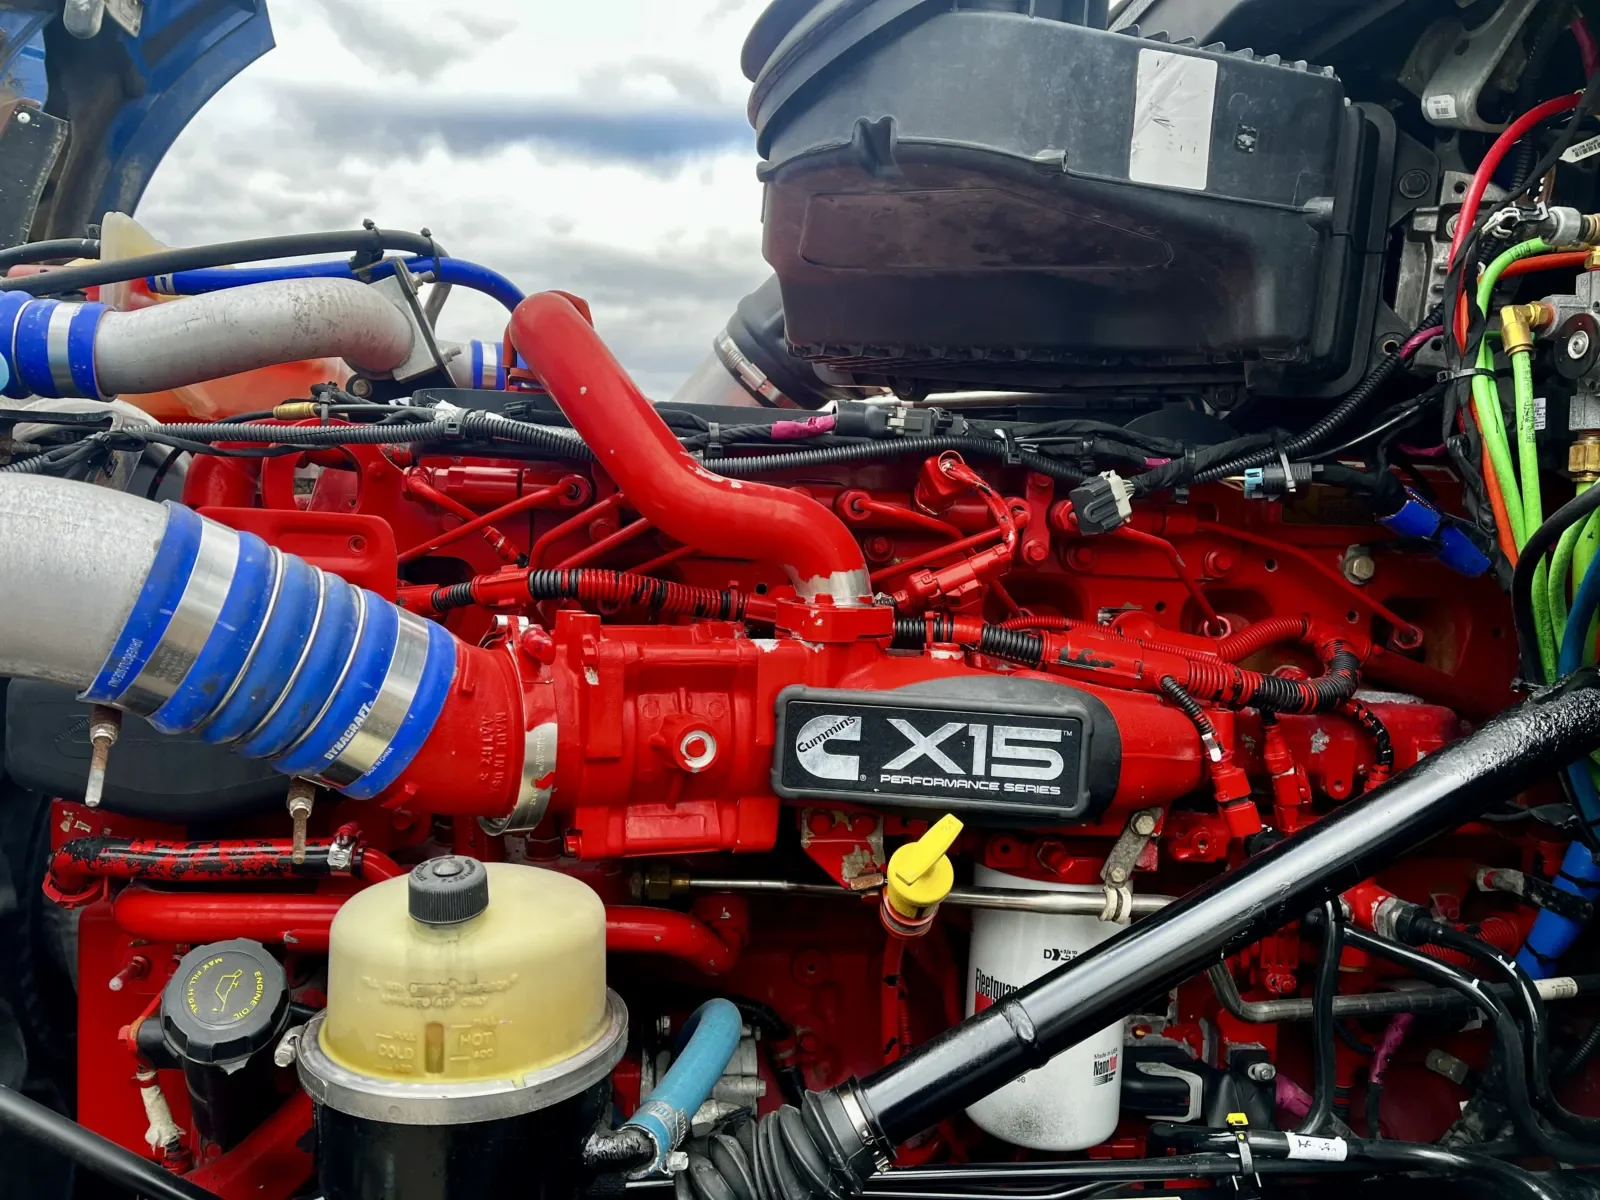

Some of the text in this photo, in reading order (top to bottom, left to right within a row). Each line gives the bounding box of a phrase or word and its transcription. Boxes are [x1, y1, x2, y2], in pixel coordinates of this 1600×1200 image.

[324, 702, 371, 760] DYNACRAFT
[797, 716, 856, 753] Cummins
[380, 747, 395, 763] CHINA
[882, 718, 1064, 781] X15
[880, 774, 1061, 795] PERFORMANCE SERIES
[203, 957, 223, 970] MAX
[189, 970, 202, 985] FILL
[233, 970, 264, 1020] ENGINE OIL
[188, 998, 199, 1014] GAL
[460, 1032, 493, 1046] HOT
[378, 1043, 414, 1060] COLD
